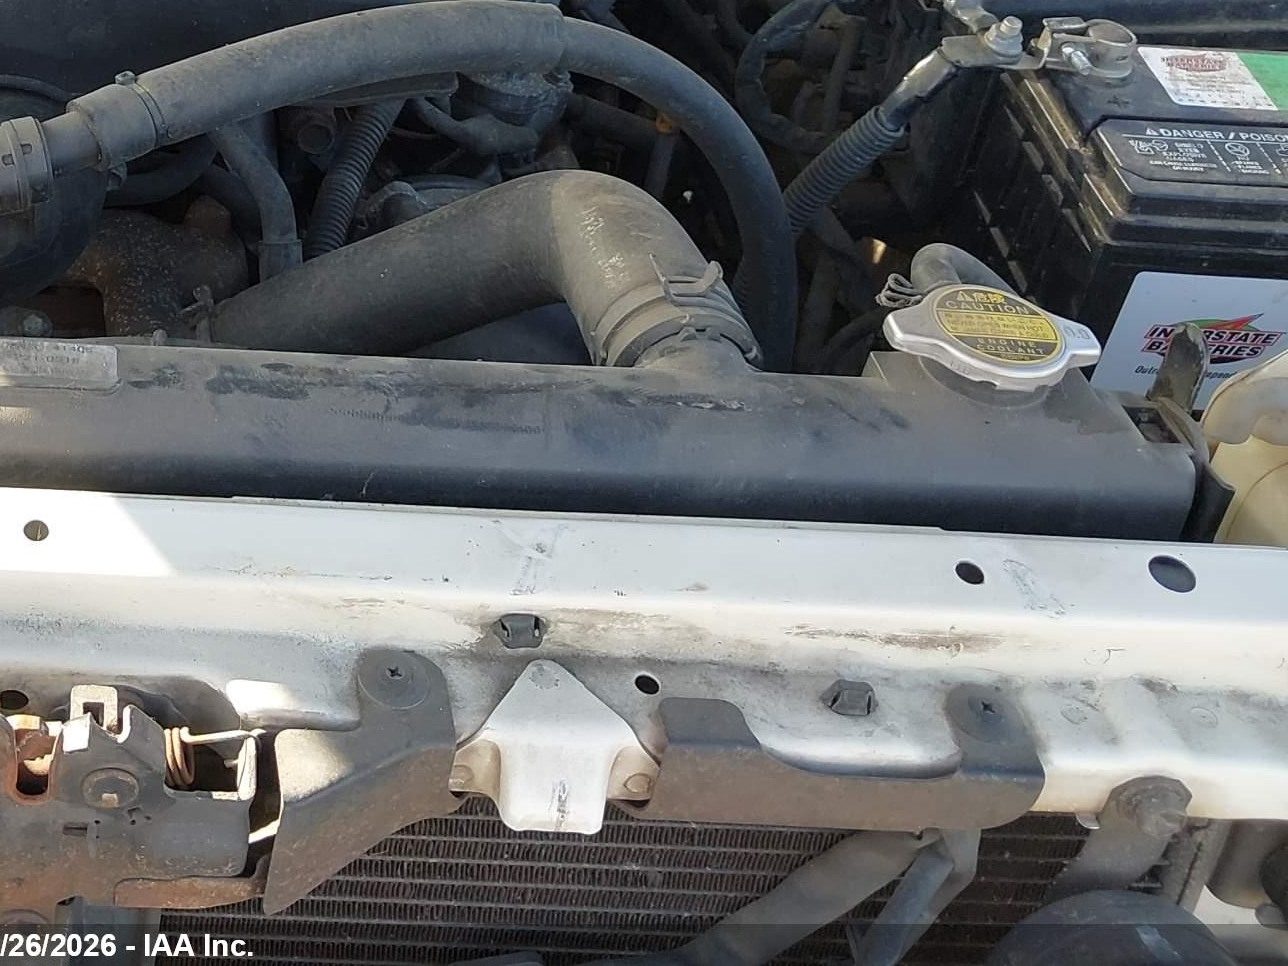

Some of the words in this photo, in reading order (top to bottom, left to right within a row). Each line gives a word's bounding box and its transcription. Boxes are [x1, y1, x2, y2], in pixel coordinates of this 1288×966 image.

[1159, 128, 1225, 140] DANGER
[945, 300, 1030, 315] CAUTION
[1149, 327, 1278, 345] INRSTATE
[977, 338, 1037, 348] ENGINE
[976, 344, 1045, 355] COOLANT
